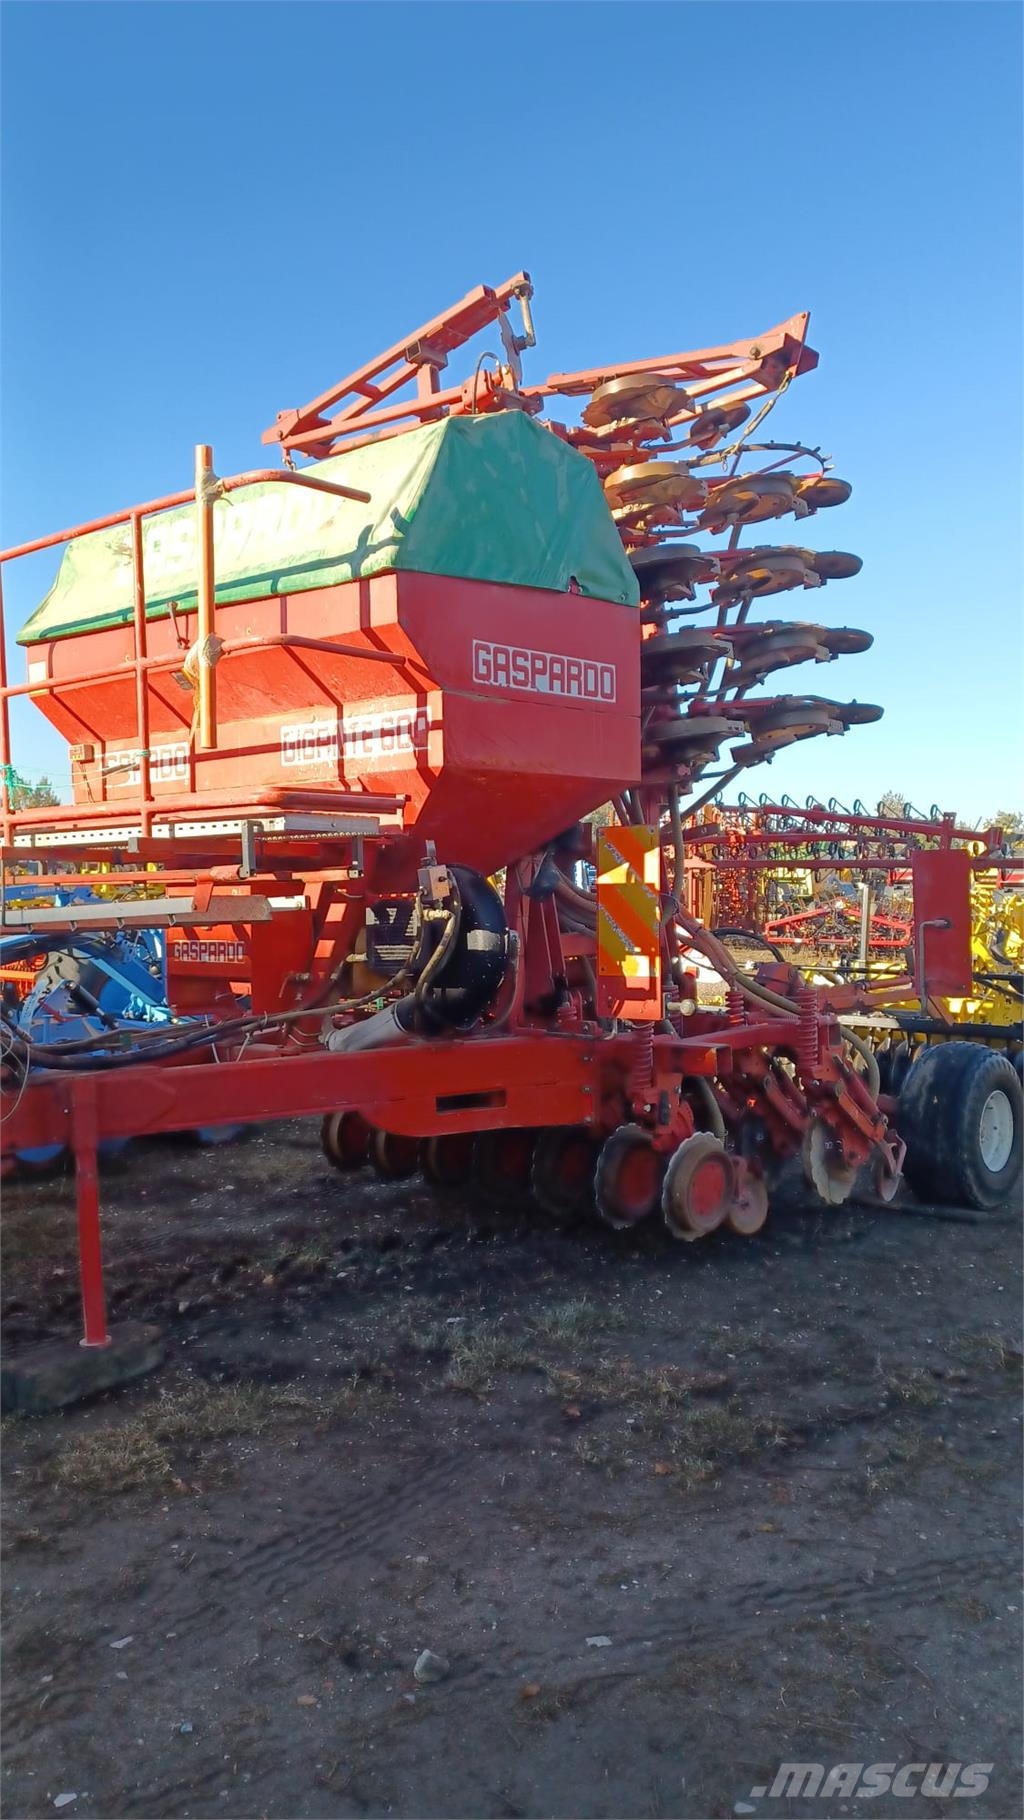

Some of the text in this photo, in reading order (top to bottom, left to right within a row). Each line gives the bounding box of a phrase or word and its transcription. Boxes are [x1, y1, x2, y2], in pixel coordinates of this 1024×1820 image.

[474, 641, 615, 701] GASPARDO
[282, 712, 429, 763] GIGANTE 600
[173, 941, 244, 963] GASPARDO
